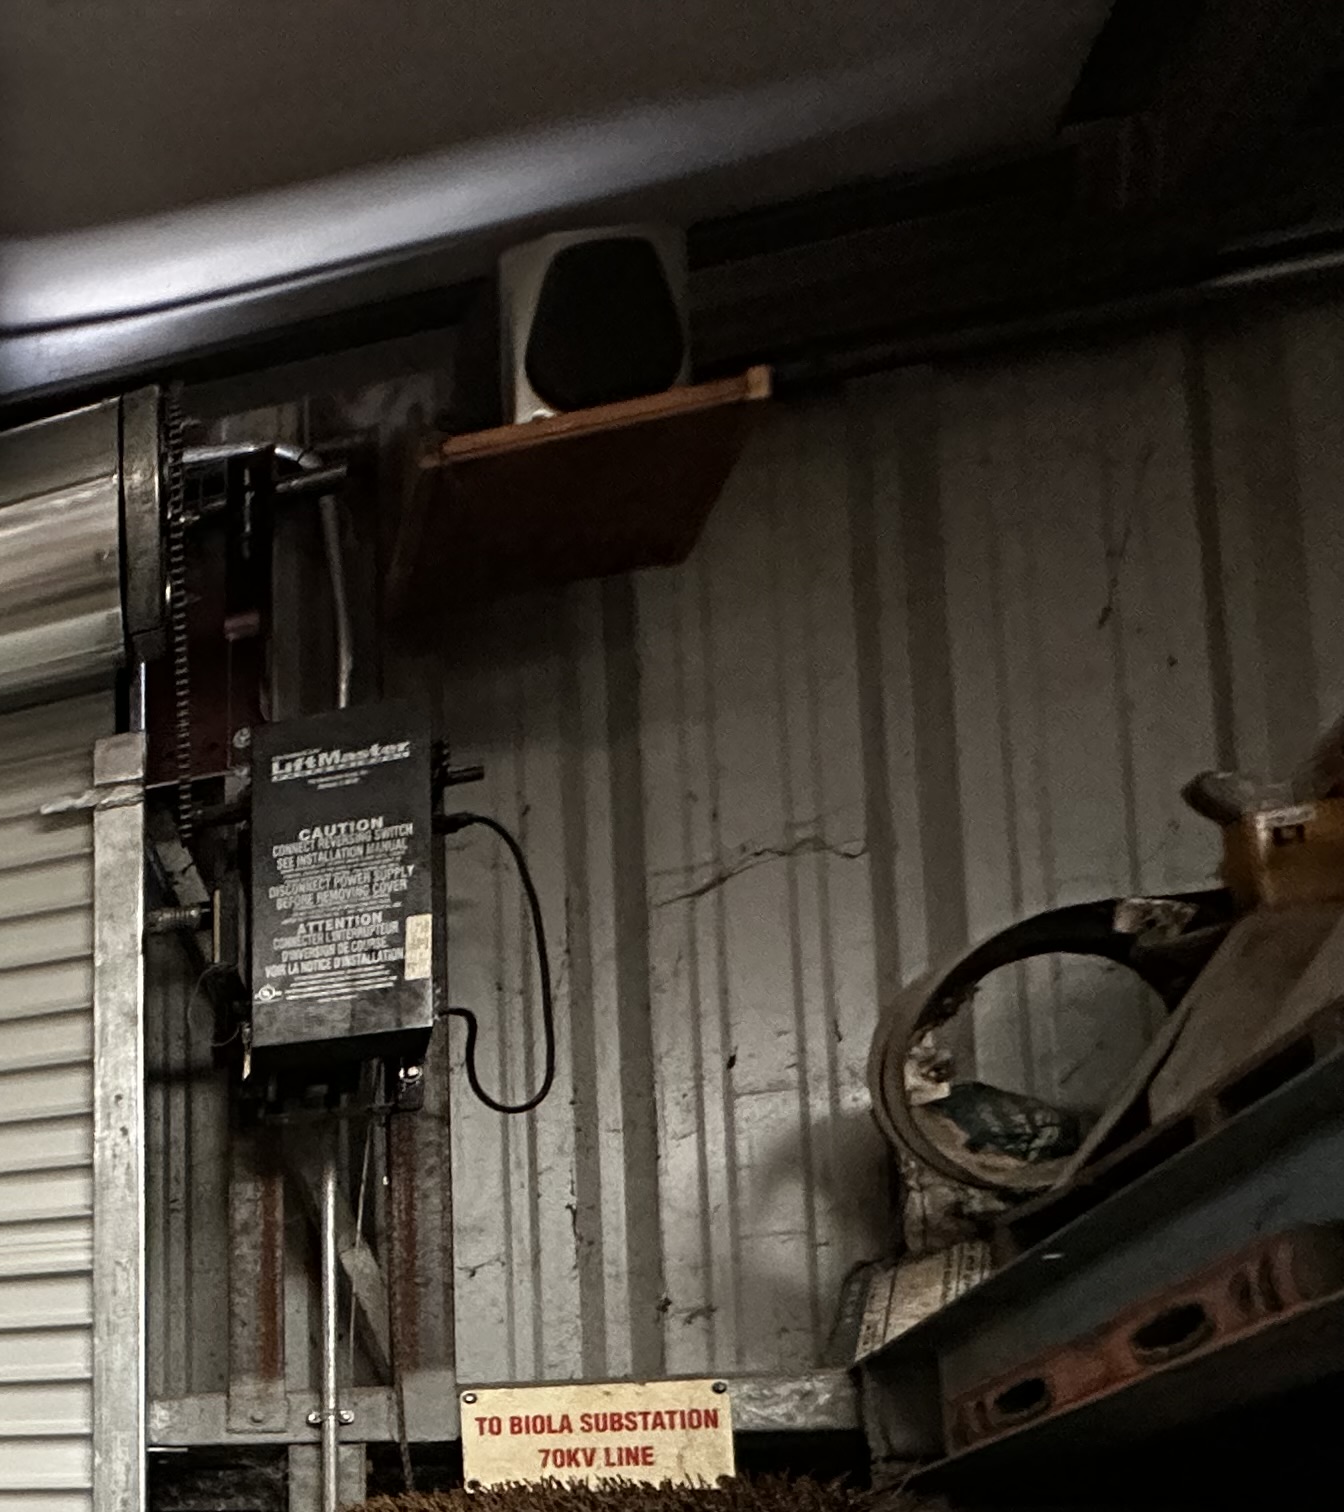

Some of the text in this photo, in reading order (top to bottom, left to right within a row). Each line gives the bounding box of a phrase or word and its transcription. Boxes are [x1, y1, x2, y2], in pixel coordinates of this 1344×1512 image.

[271, 741, 411, 776] LiftMaster
[272, 839, 315, 858] CONNECT
[373, 822, 414, 842] SWITCH
[298, 815, 384, 841] CAUTION
[276, 855, 295, 871] SEE
[296, 844, 364, 868] INSTALLATION
[365, 837, 408, 856] MANUAL
[268, 873, 331, 899] DISCONNECT
[333, 869, 371, 889] POWER
[372, 864, 415, 882] SUPPLY
[372, 878, 408, 896] COVER
[296, 910, 384, 935] ATTENTION
[337, 941, 350, 956] DE
[350, 935, 388, 952] COURSE
[300, 957, 332, 974] NOTICE
[474, 1408, 719, 1436] TO BIOLA SUBSTATION
[538, 1445, 655, 1469] 70KV LINE
